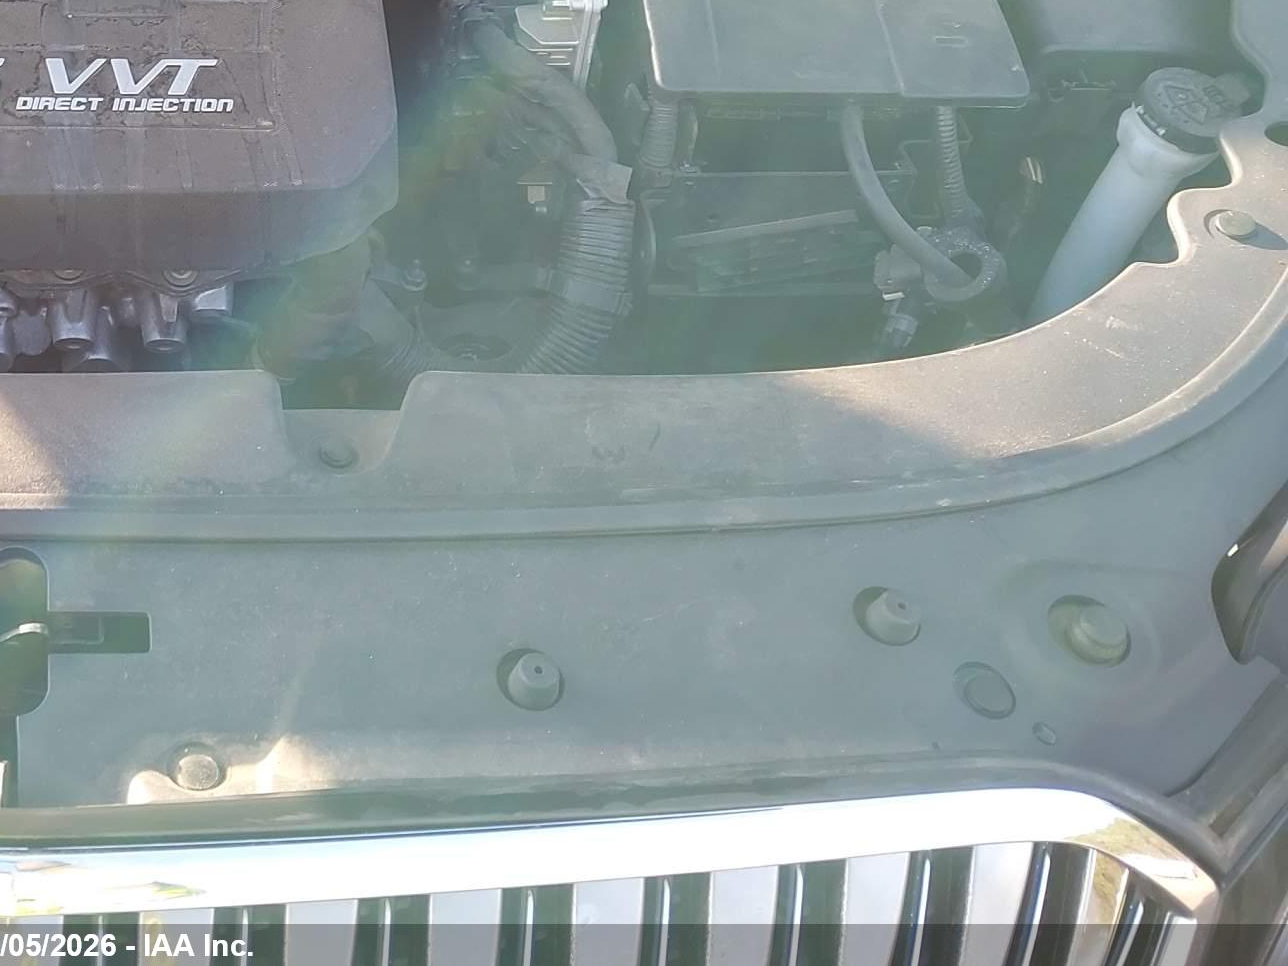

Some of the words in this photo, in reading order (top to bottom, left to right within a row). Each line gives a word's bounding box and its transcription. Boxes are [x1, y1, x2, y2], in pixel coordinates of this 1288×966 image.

[45, 58, 219, 95] VVT
[15, 96, 104, 111] DIRECT
[112, 97, 234, 112] INJECTION
